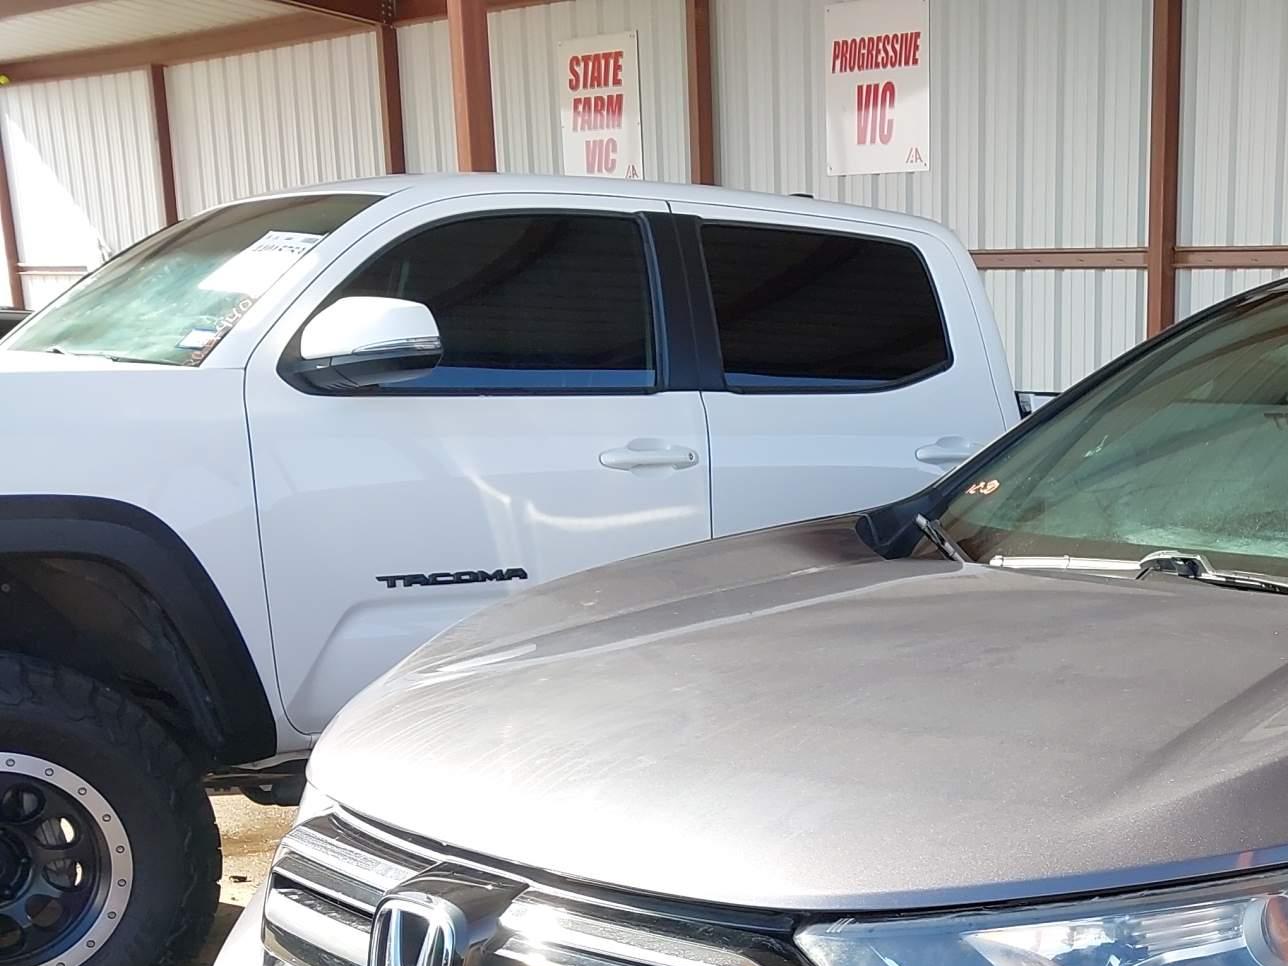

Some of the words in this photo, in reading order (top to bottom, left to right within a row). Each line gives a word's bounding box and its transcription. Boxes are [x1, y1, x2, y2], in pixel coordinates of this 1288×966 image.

[568, 50, 624, 92] STATE
[831, 31, 922, 74] PROGRESSIVE
[571, 93, 624, 133] FARM
[855, 81, 896, 146] VIC
[584, 138, 618, 174] VIC
[375, 567, 529, 589] TACOMA
